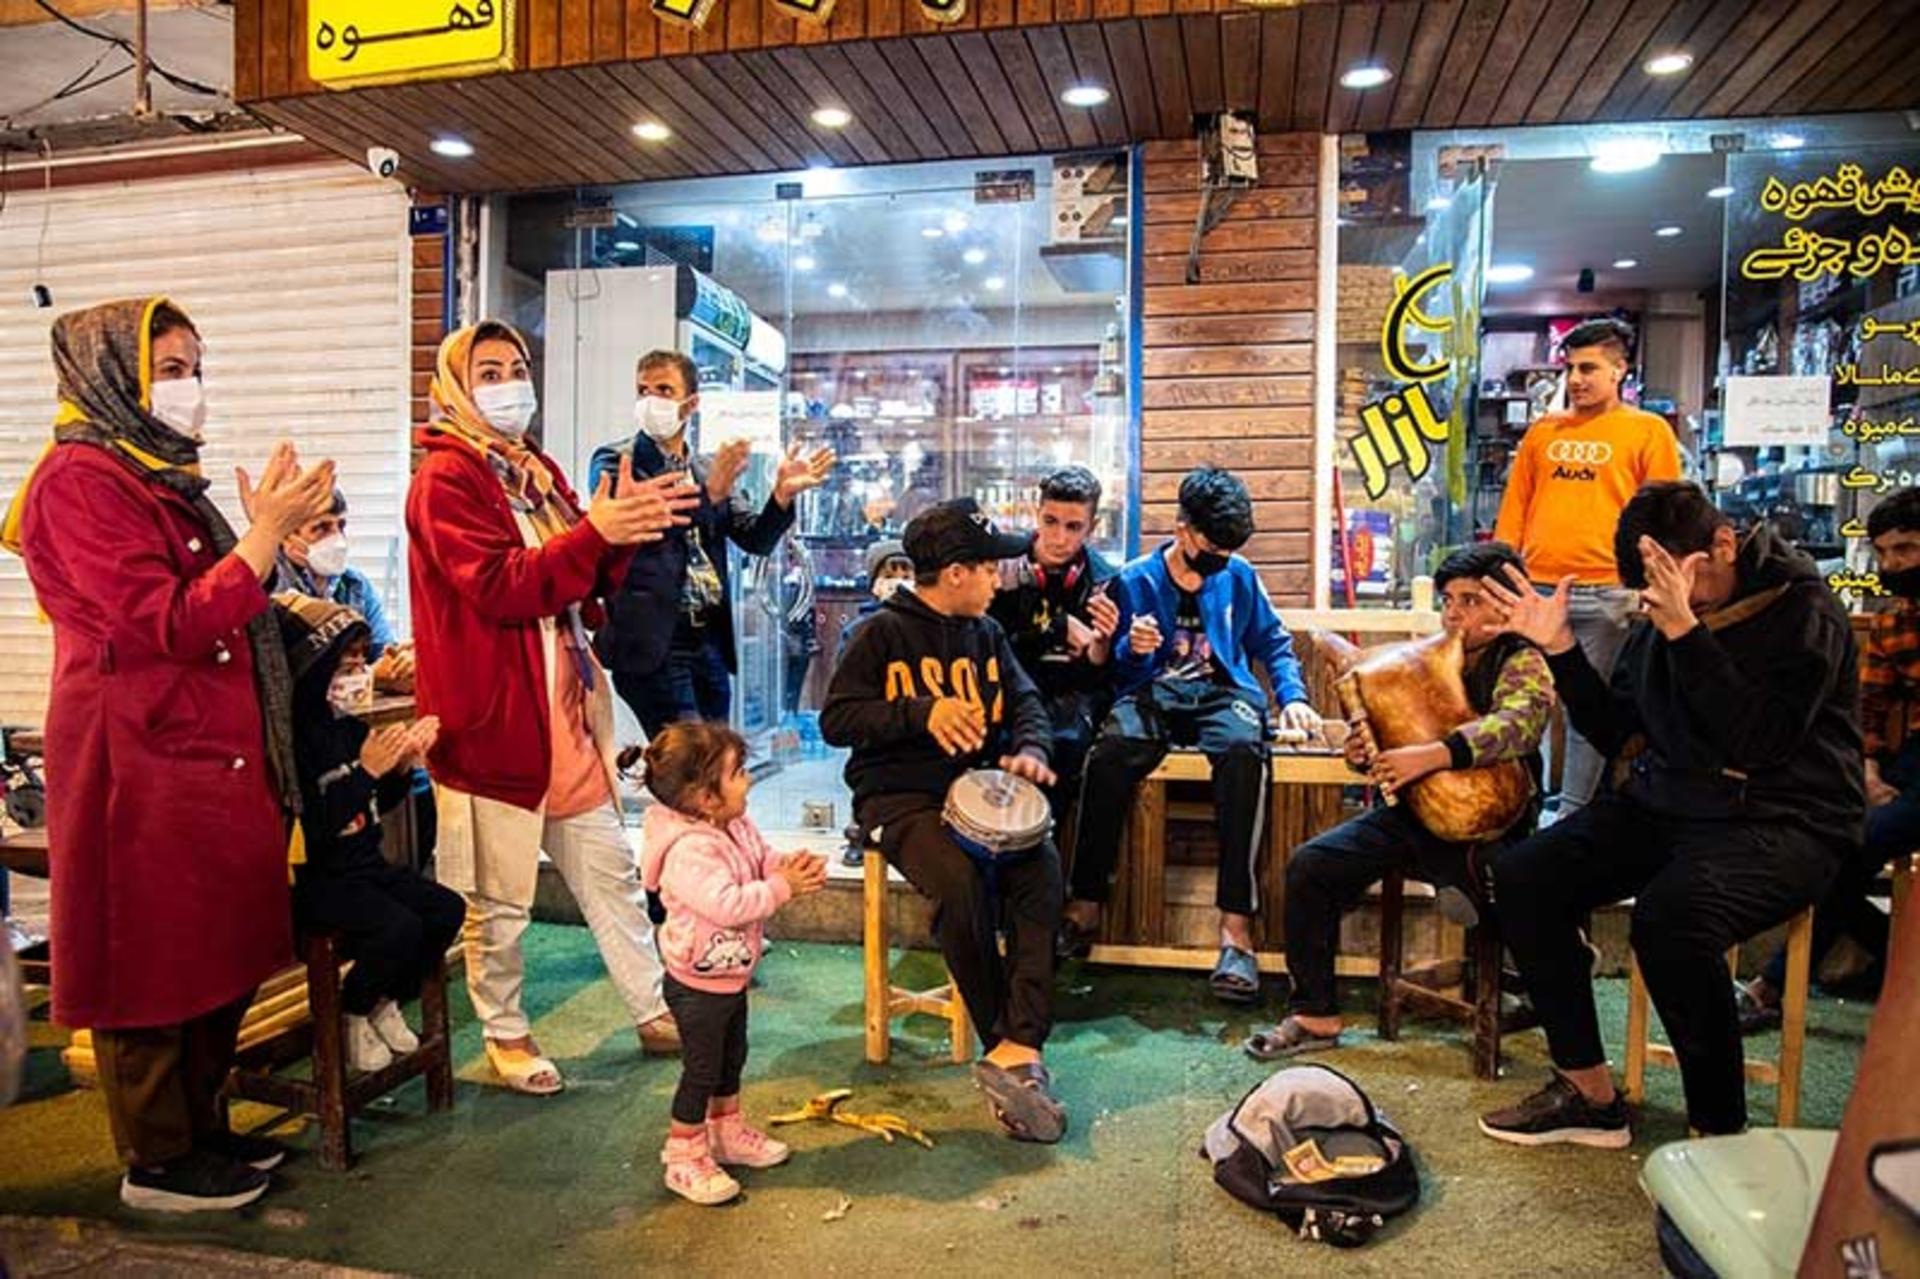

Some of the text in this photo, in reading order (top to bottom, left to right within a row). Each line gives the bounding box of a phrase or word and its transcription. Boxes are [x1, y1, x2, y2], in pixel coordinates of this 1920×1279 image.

[1761, 163, 1861, 220] قهوه
[1842, 418, 1898, 443] میوه
[1551, 464, 1597, 481] Audi
[1840, 466, 1896, 494] ترک
